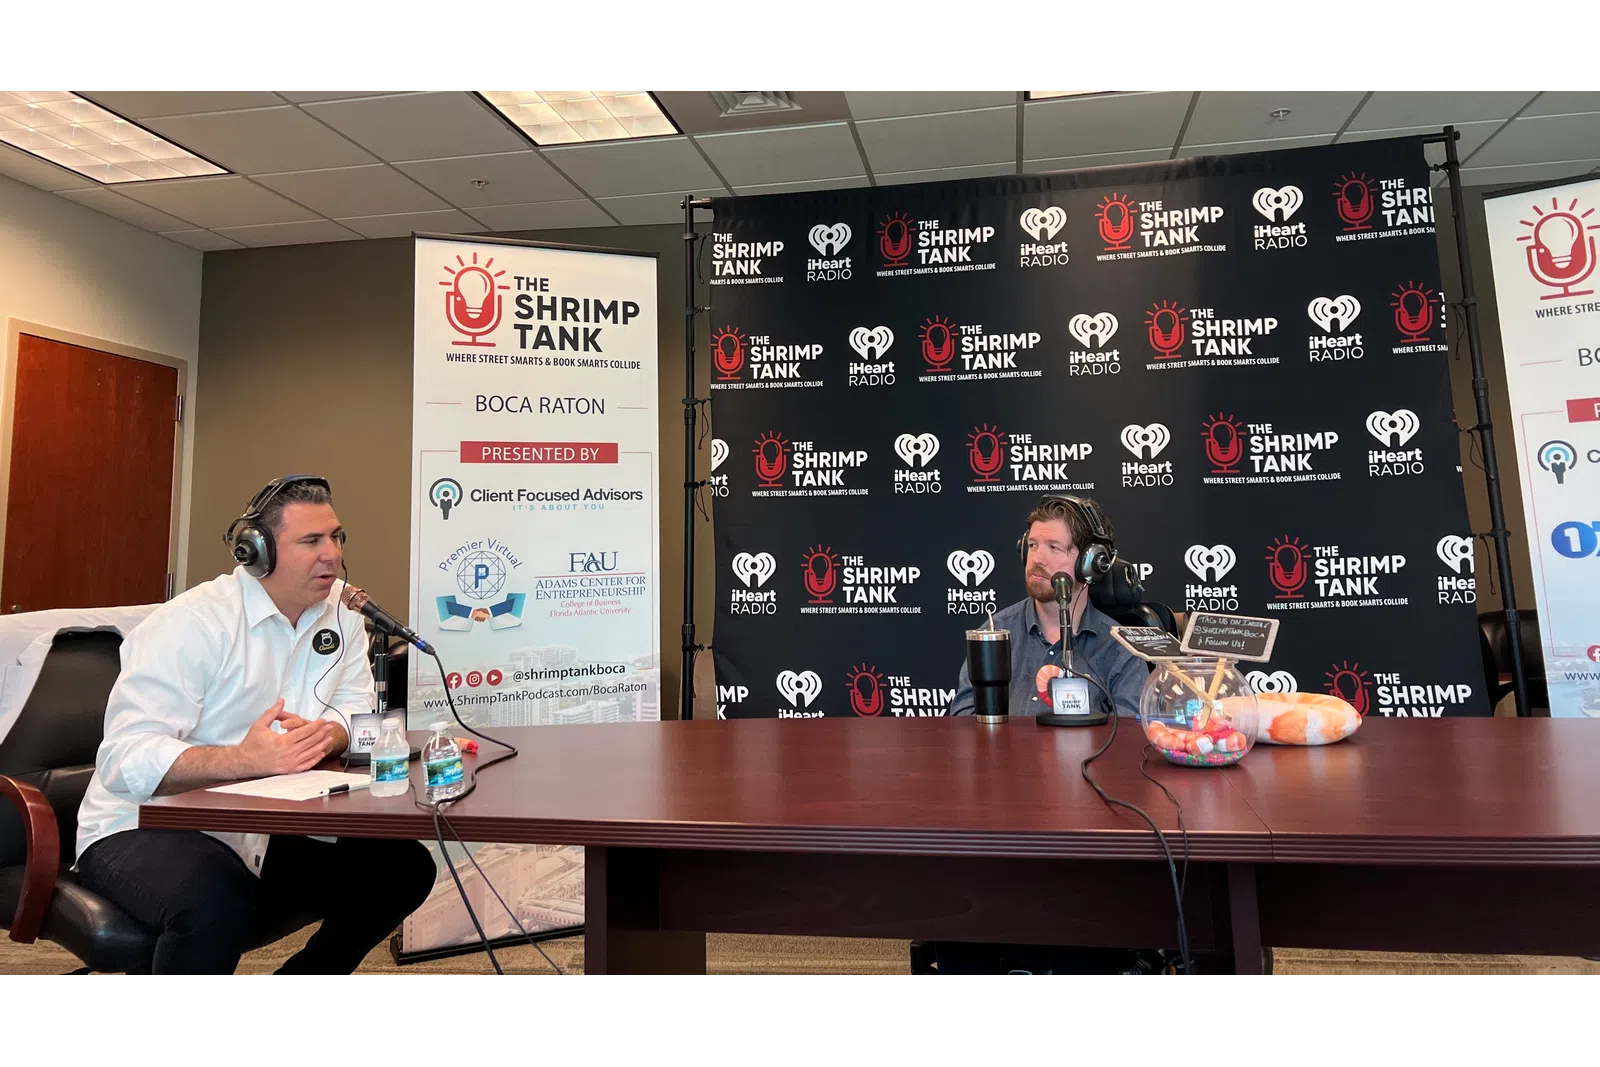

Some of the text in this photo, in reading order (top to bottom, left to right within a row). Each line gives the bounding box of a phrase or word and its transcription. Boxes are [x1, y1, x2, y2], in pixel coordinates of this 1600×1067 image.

[1380, 179, 1404, 190] THE
[1139, 201, 1163, 212] THE
[1141, 206, 1224, 229] SHRIMP
[918, 220, 939, 230] THE
[1254, 222, 1306, 238] iHeart
[713, 233, 732, 242] THE
[918, 226, 994, 247] SHRIMP
[1141, 226, 1200, 247] TANK
[1255, 235, 1308, 250] RADIO
[713, 241, 784, 258] SHRIMP
[918, 246, 971, 264] TANK
[1021, 242, 1068, 256] iHeart
[1117, 252, 1136, 260] STREET
[713, 259, 762, 275] TANK
[808, 257, 851, 270] iHeart
[1021, 254, 1069, 267] RADIO
[807, 269, 852, 282] RADIO
[514, 276, 549, 292] THE
[514, 294, 640, 325] SHRIMP
[1190, 308, 1214, 319] THE
[1536, 306, 1572, 318] WHERE
[960, 325, 982, 335] THE
[1192, 318, 1278, 337] SHRIMP
[514, 324, 603, 352] TANK
[750, 336, 769, 345] THE
[961, 332, 1041, 352] SHRIMP
[1309, 333, 1362, 349] iHeart
[750, 344, 823, 362] SHRIMP
[1192, 338, 1252, 356] TANK
[446, 353, 641, 369] WHERE STREET SMARTS & BOOK SMARTS COLLIDE
[962, 352, 1017, 370] TANK
[1070, 349, 1119, 364] iHeart
[1309, 347, 1364, 362] RADIO
[750, 363, 801, 379] TANK
[850, 362, 895, 374] iHeart
[1070, 362, 1121, 376] RADIO
[1167, 361, 1186, 369] STREET
[849, 374, 895, 386] RADIO
[476, 395, 605, 414] BOCA RATON
[1248, 423, 1273, 434] THE
[792, 441, 813, 451] THE
[1009, 434, 1032, 444] THE
[1250, 431, 1339, 453] SHRIMP
[482, 447, 599, 461] PRESENTED BY
[1010, 443, 1093, 462] SHRIMP
[1369, 448, 1422, 463] iHeart
[793, 451, 868, 469] SHRIMP
[1250, 453, 1313, 473] TANK
[1010, 463, 1068, 481] TANK
[1122, 461, 1172, 475] iHeart
[1369, 461, 1424, 477] RADIO
[792, 470, 844, 487] TANK
[894, 469, 940, 482] iHeart
[1122, 474, 1173, 487] RADIO
[470, 488, 643, 502] Client Focused Advisors
[895, 482, 941, 494] RADIO
[439, 538, 523, 571] Premier Virtual
[1314, 546, 1339, 558] THE
[842, 556, 863, 566] THE
[1315, 554, 1406, 577] SHRIMP
[843, 566, 920, 584] SHRIMP
[536, 576, 645, 589] ADAMS CENTER FOR
[1315, 577, 1379, 597] TANK
[536, 587, 645, 600] ENTREPRENEURSHIP
[732, 589, 776, 602] iHeart
[843, 586, 897, 603] TANK
[948, 589, 996, 601] iHeart
[1185, 584, 1237, 598] iHeart
[1439, 591, 1476, 604] RAD
[731, 602, 777, 615] RADIO
[900, 606, 921, 614] COLLIDE
[948, 601, 997, 615] RADIO
[1186, 598, 1239, 611] RADIO
[550, 608, 572, 617] Florida
[1199, 616, 1216, 624] TAG
[513, 663, 625, 682] @shrimptankboca
[1374, 673, 1400, 685] THE
[888, 676, 910, 686] THE
[890, 689, 956, 706] SHRIM
[1378, 684, 1472, 705] SHRIMP
